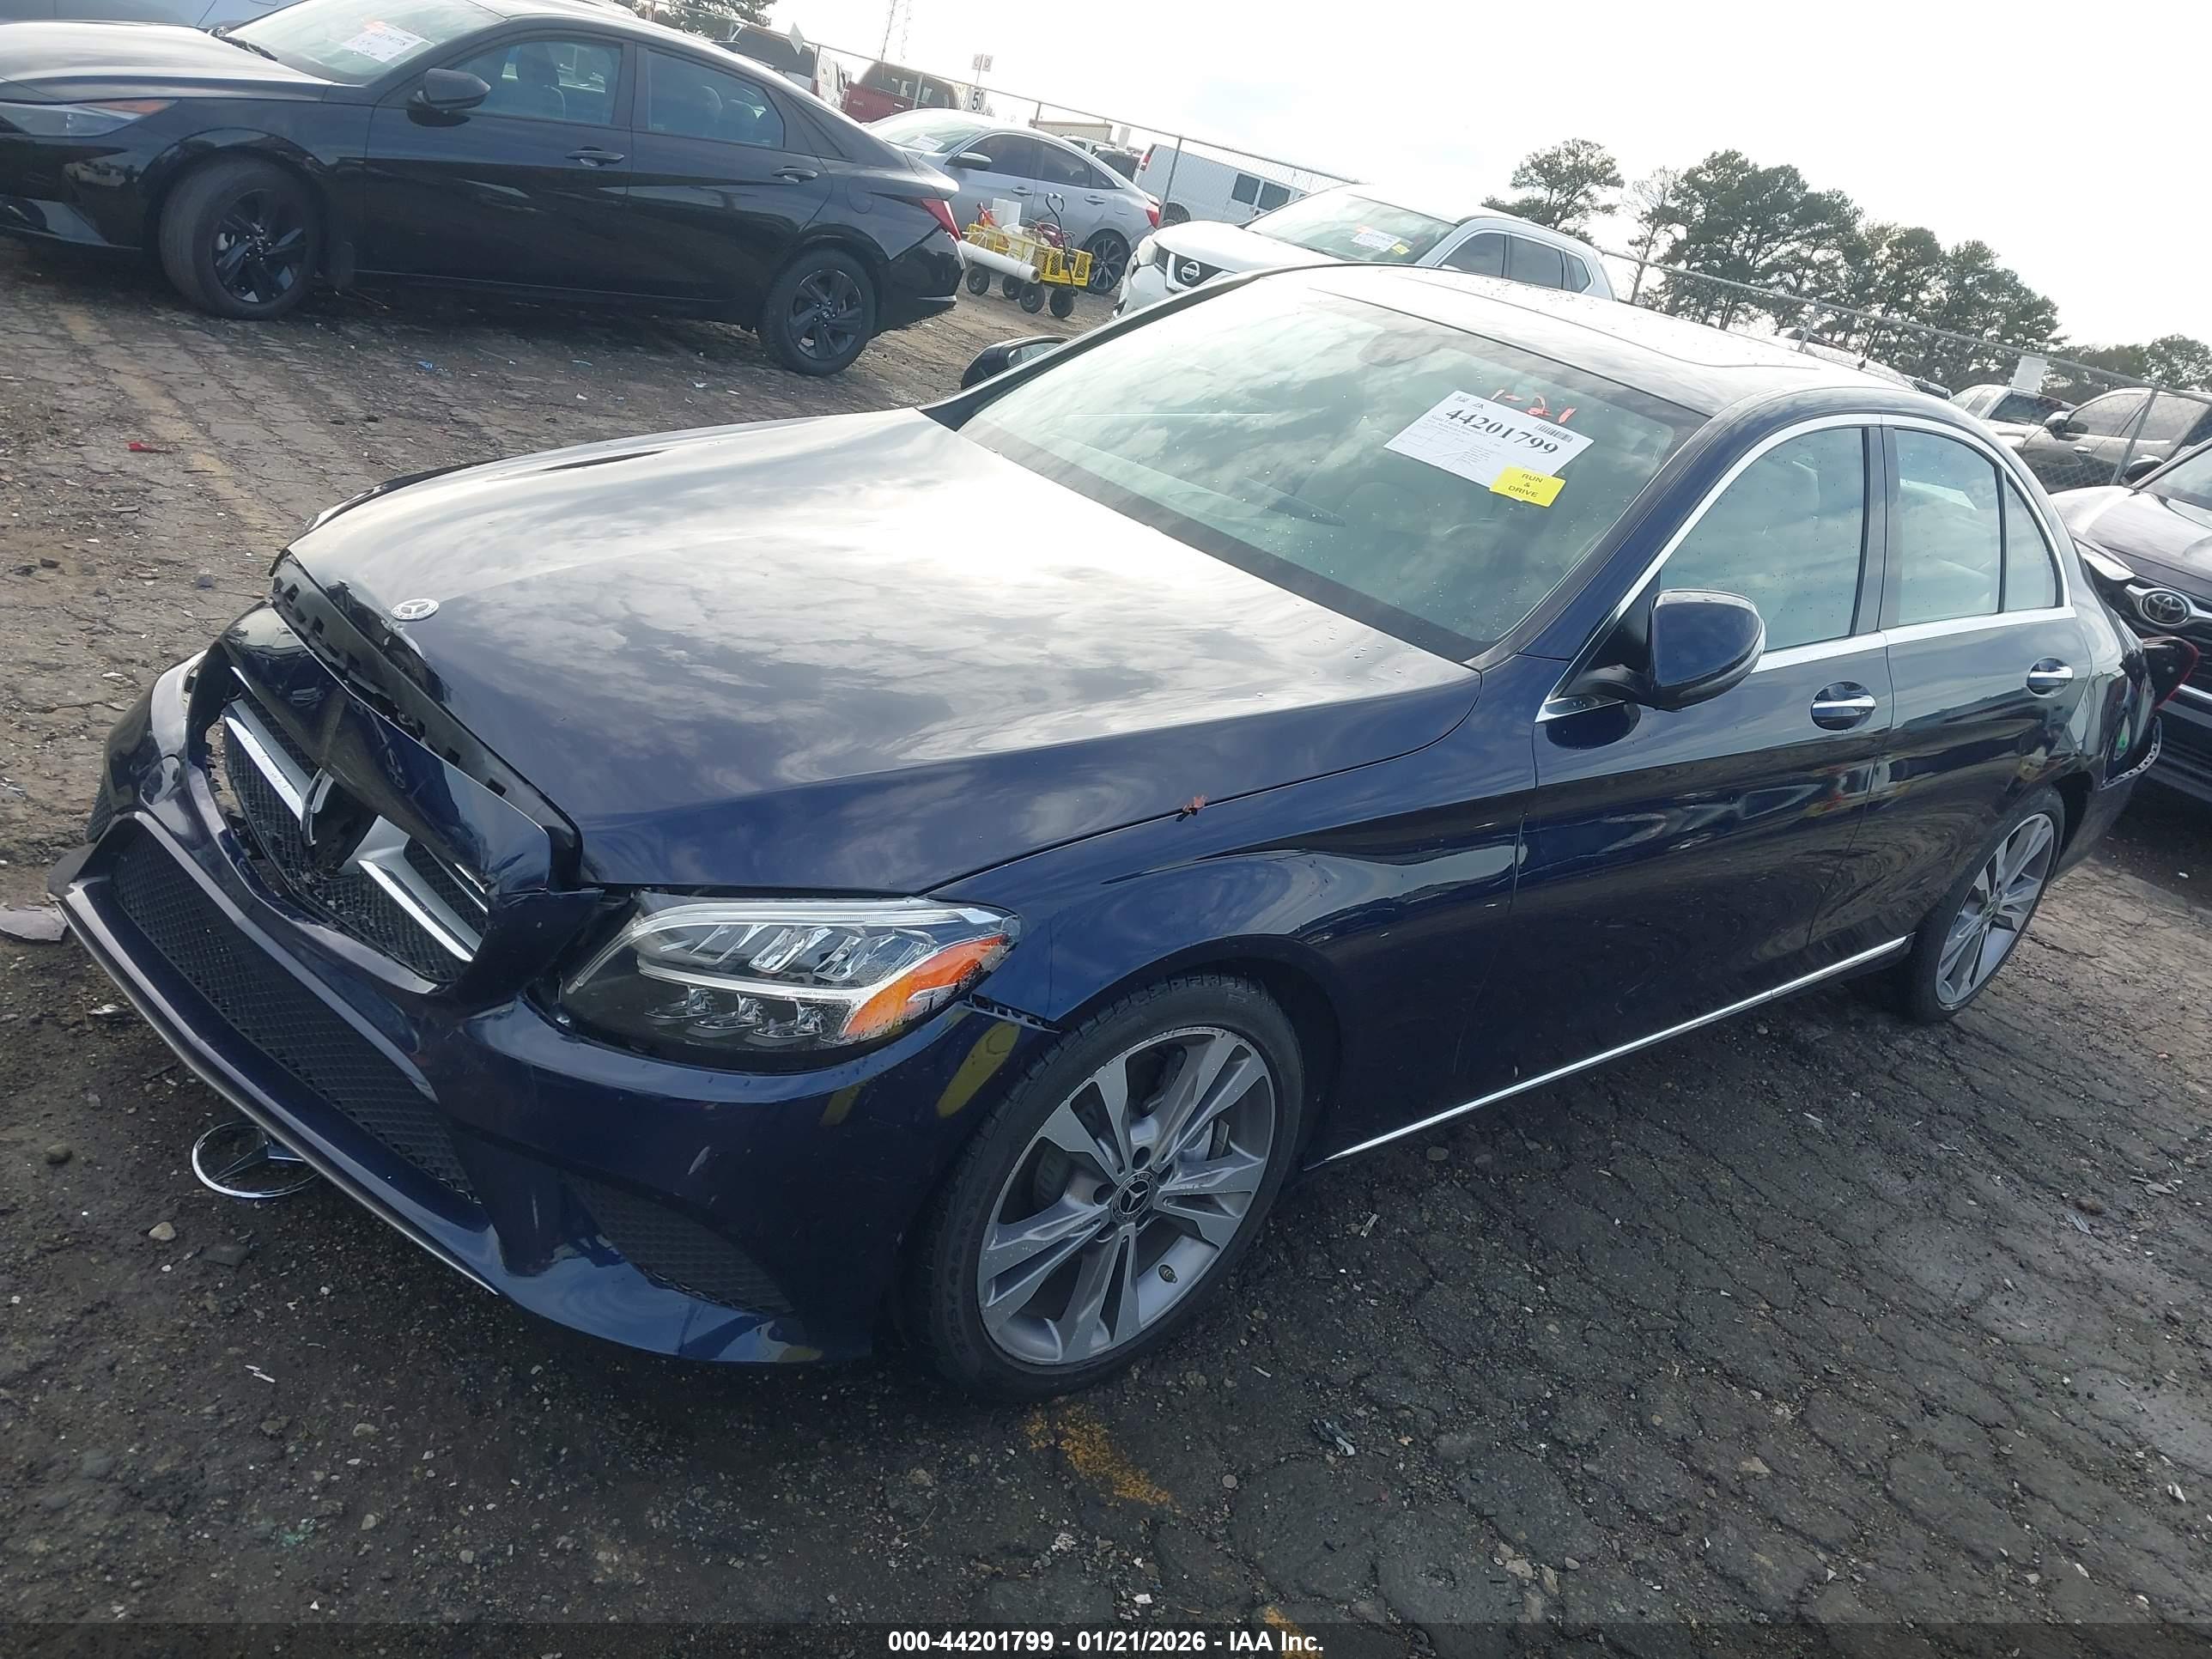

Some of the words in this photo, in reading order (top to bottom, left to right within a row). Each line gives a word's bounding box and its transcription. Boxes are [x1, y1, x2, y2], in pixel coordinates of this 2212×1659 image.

[971, 90, 984, 111] 50
[1445, 408, 1559, 455] 44201799
[1521, 473, 1544, 483] RUN
[1508, 485, 1539, 498] DRIVE
